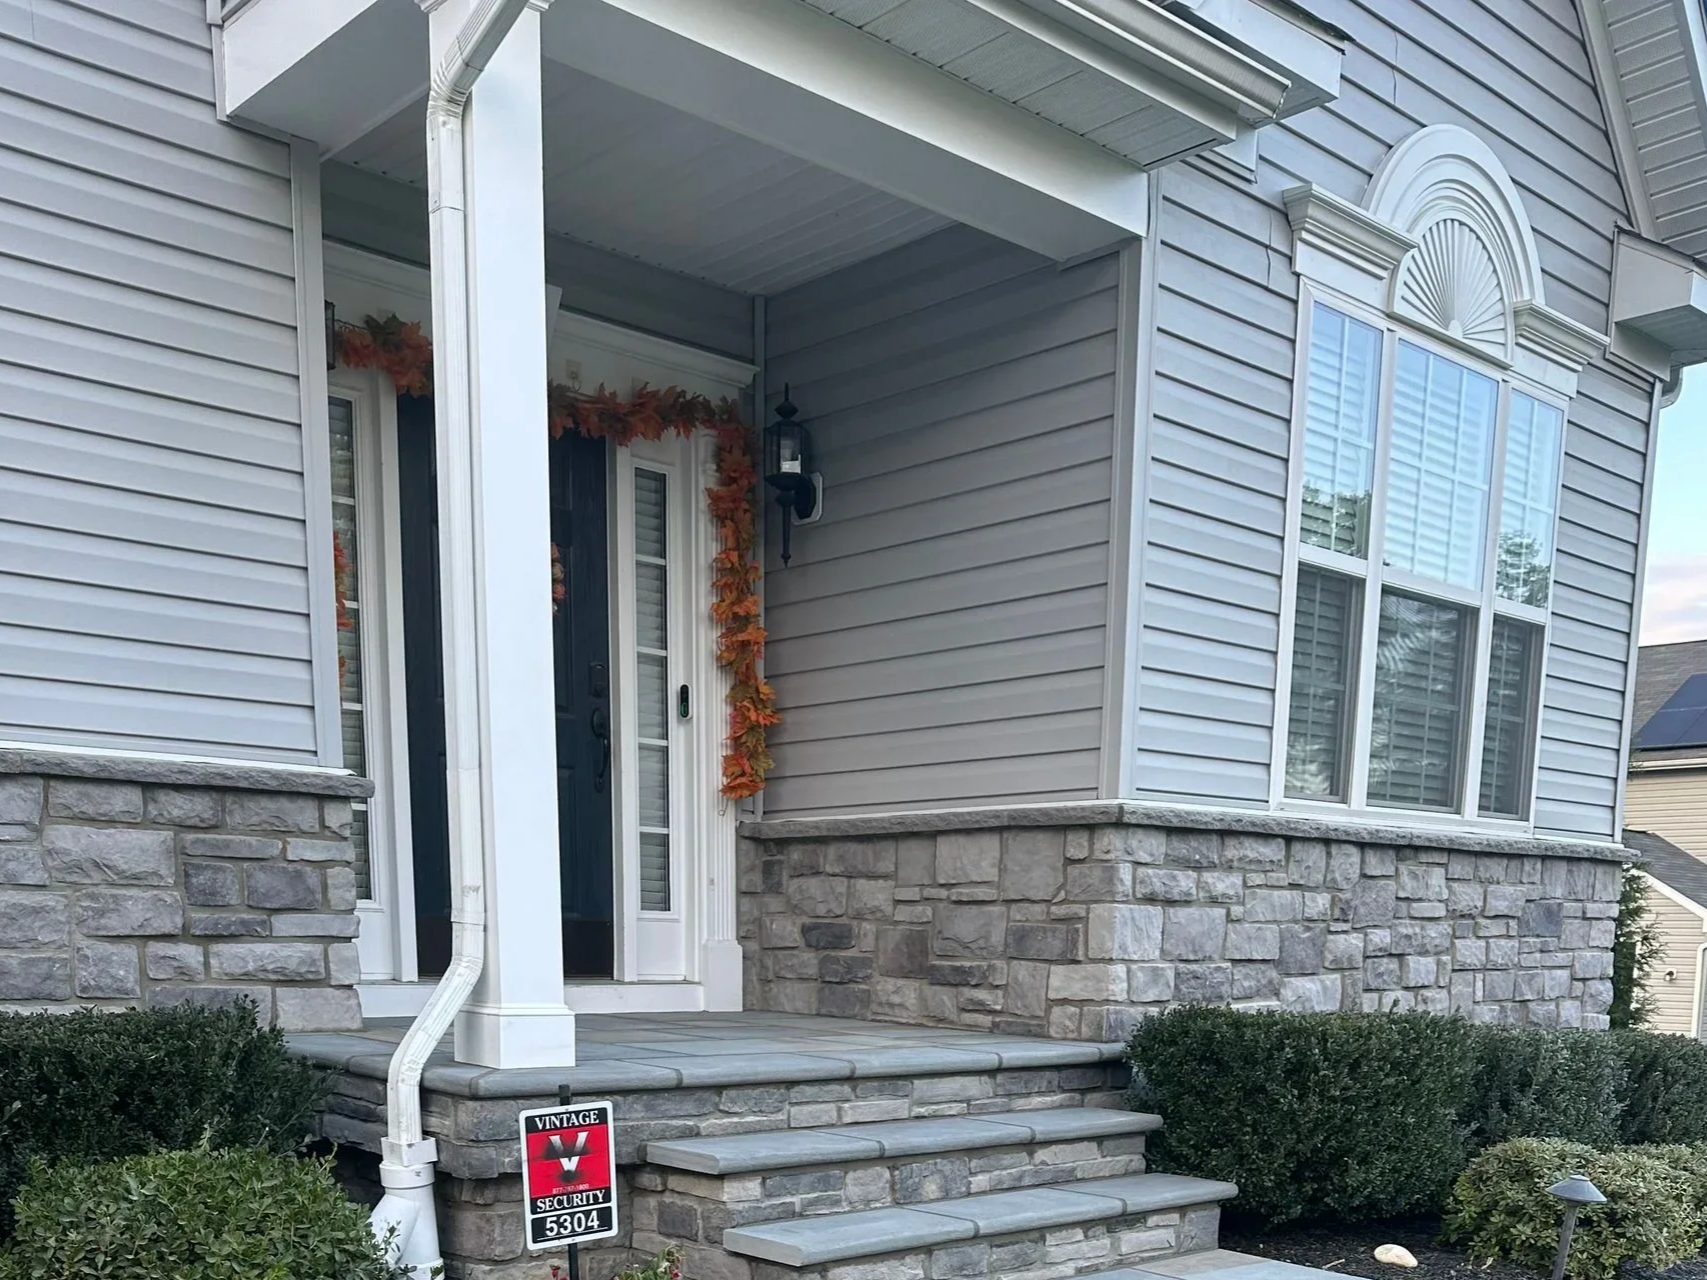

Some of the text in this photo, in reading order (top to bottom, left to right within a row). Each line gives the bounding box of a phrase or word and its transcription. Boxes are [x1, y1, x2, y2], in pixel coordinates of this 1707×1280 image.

[534, 1110, 599, 1130] VINTAGE
[548, 1131, 589, 1173] V
[536, 1189, 605, 1212] SECURITY
[545, 1210, 600, 1237] 5304
